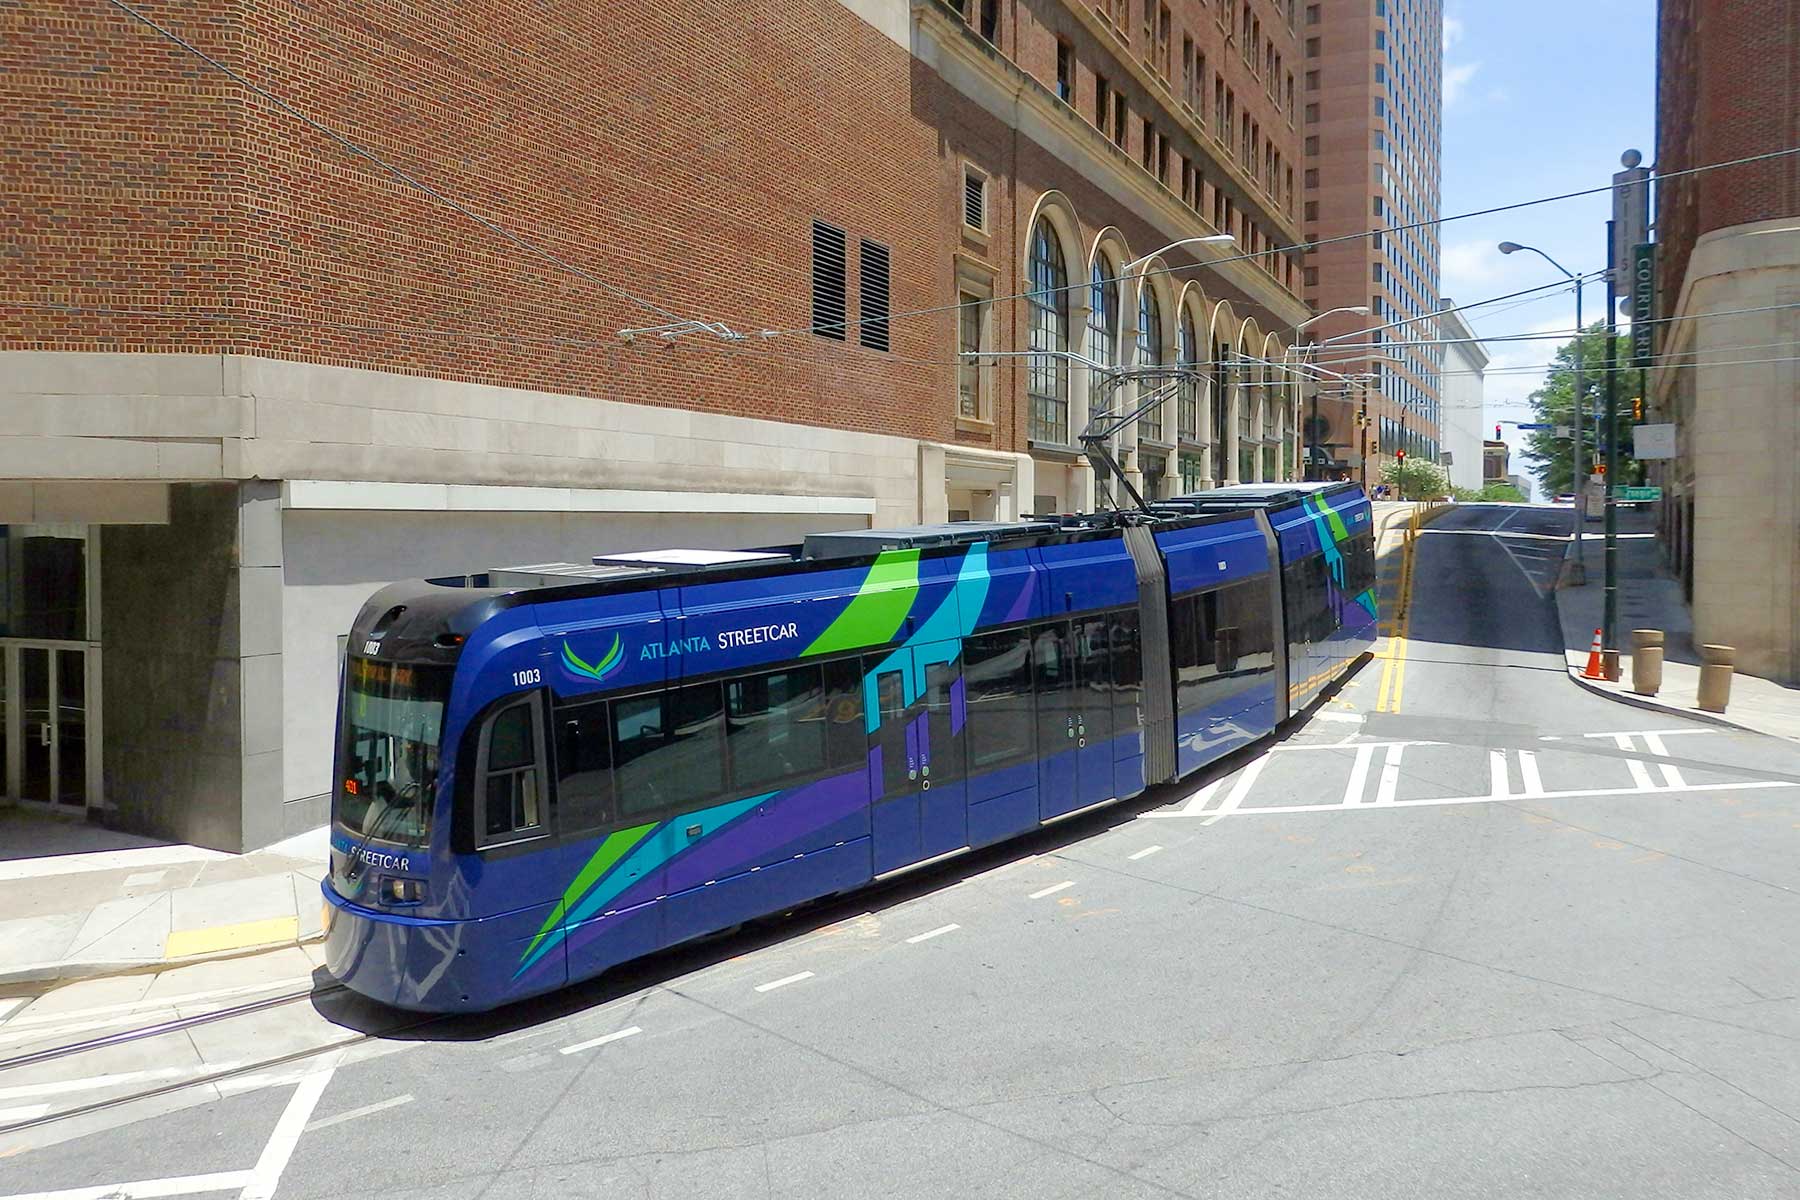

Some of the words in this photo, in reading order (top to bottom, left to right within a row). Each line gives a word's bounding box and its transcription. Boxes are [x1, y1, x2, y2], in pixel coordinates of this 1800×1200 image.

[1637, 257, 1652, 358] COURTYARD
[640, 637, 710, 661] ATLANTA
[718, 623, 798, 650] STREETCAR
[512, 668, 541, 687] 1003
